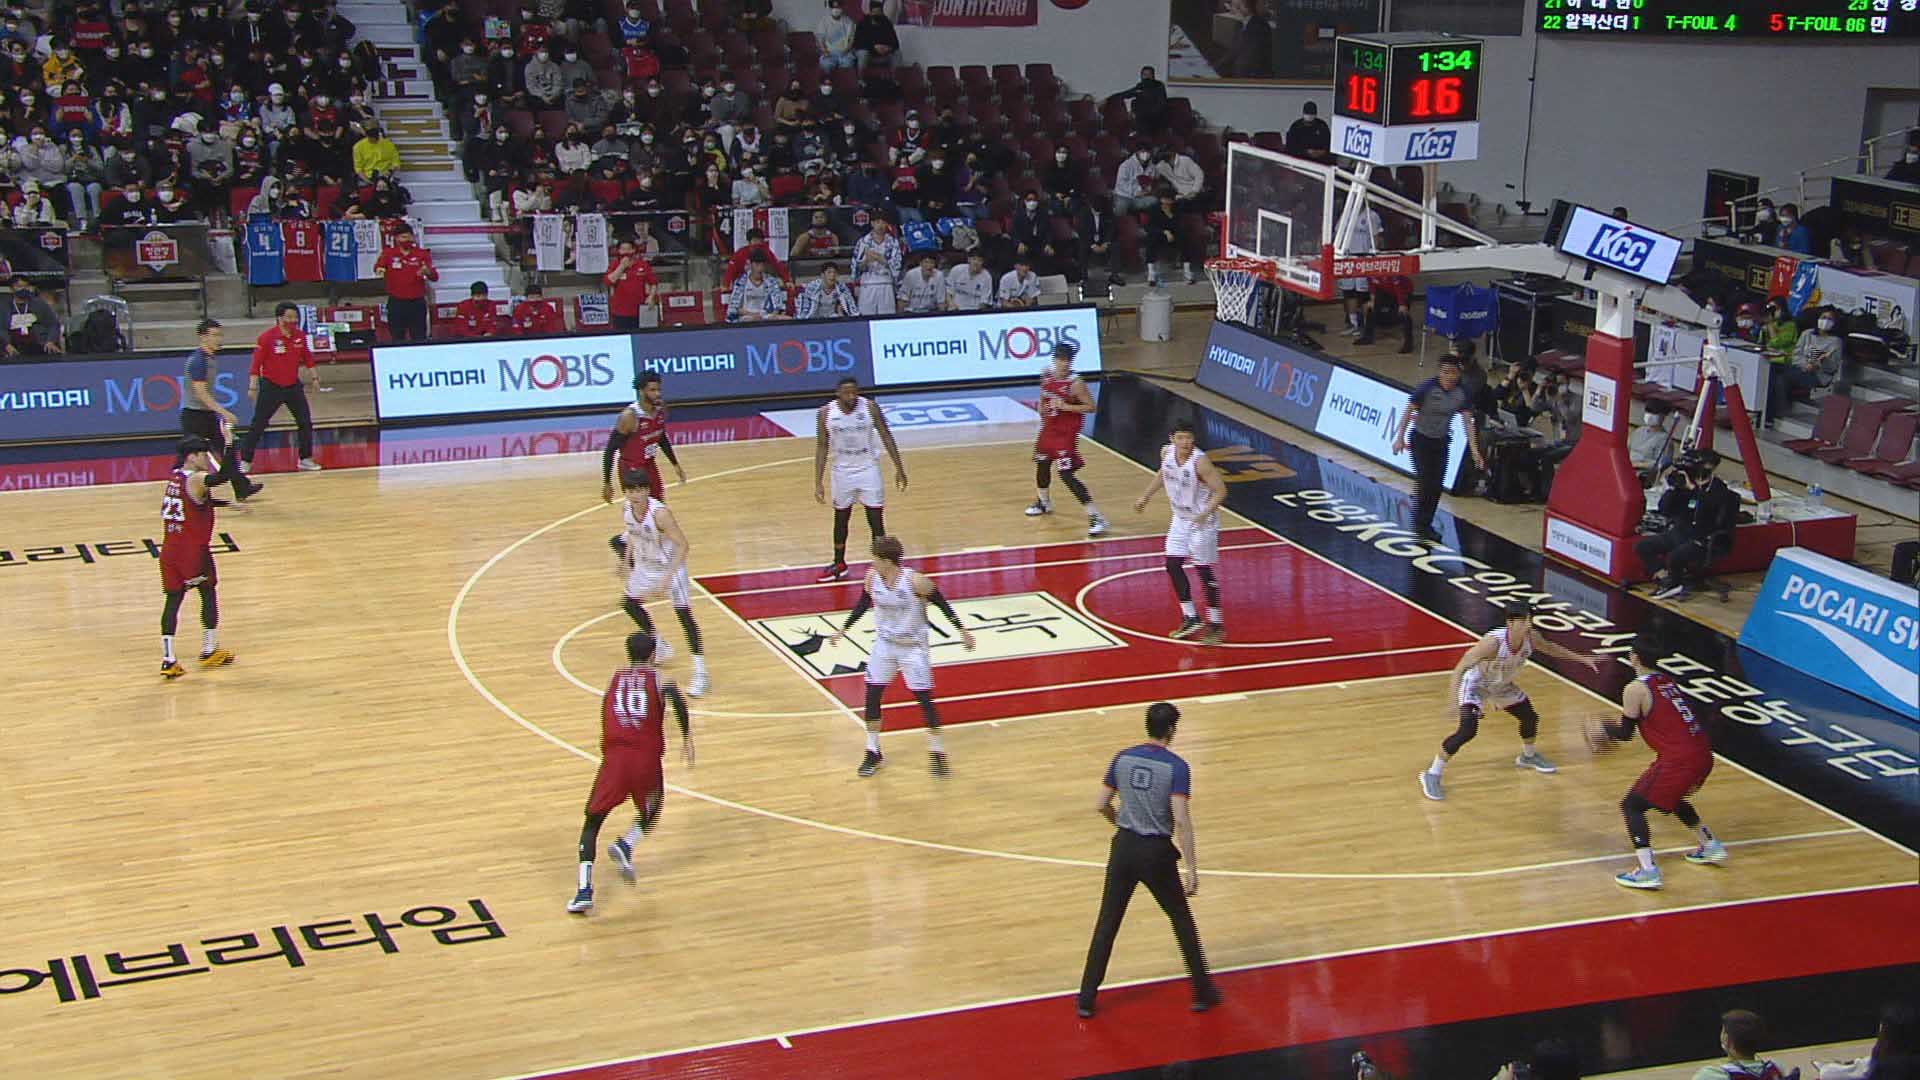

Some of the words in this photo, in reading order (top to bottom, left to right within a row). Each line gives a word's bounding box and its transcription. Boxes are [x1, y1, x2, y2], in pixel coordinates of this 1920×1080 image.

[1543, 15, 1561, 30] 22
[1565, 13, 1628, 31] 알렉산더
[1632, 16, 1640, 30] 1
[1665, 15, 1718, 30] T-FOUL
[1724, 15, 1736, 31] 4
[1770, 14, 1784, 31] 5
[1787, 16, 1842, 31] T-FOUL
[1845, 17, 1866, 32] 86
[1352, 48, 1383, 70] 1:34
[1418, 50, 1473, 72] 1:34
[1347, 75, 1377, 113] 16
[1410, 77, 1462, 117] 16
[1347, 127, 1371, 156] KCC
[1408, 130, 1453, 158] KCC
[331, 233, 349, 251] 21
[1593, 227, 1651, 269] KCC
[645, 353, 735, 374] HYUNDAI
[746, 338, 855, 377] MOBIS
[883, 340, 968, 360] HYUNDAI
[978, 324, 1081, 361] MOBIS
[389, 367, 486, 389] HYUNDAI
[498, 352, 615, 393] MOBIS
[1208, 344, 1256, 376] HYUNDAI
[1256, 356, 1319, 408] MOBIS
[1329, 393, 1382, 426] HYUNDAI
[161, 496, 186, 522] 23
[1781, 574, 1889, 636] POCARI
[0, 899, 506, 1003] 에브리타임
